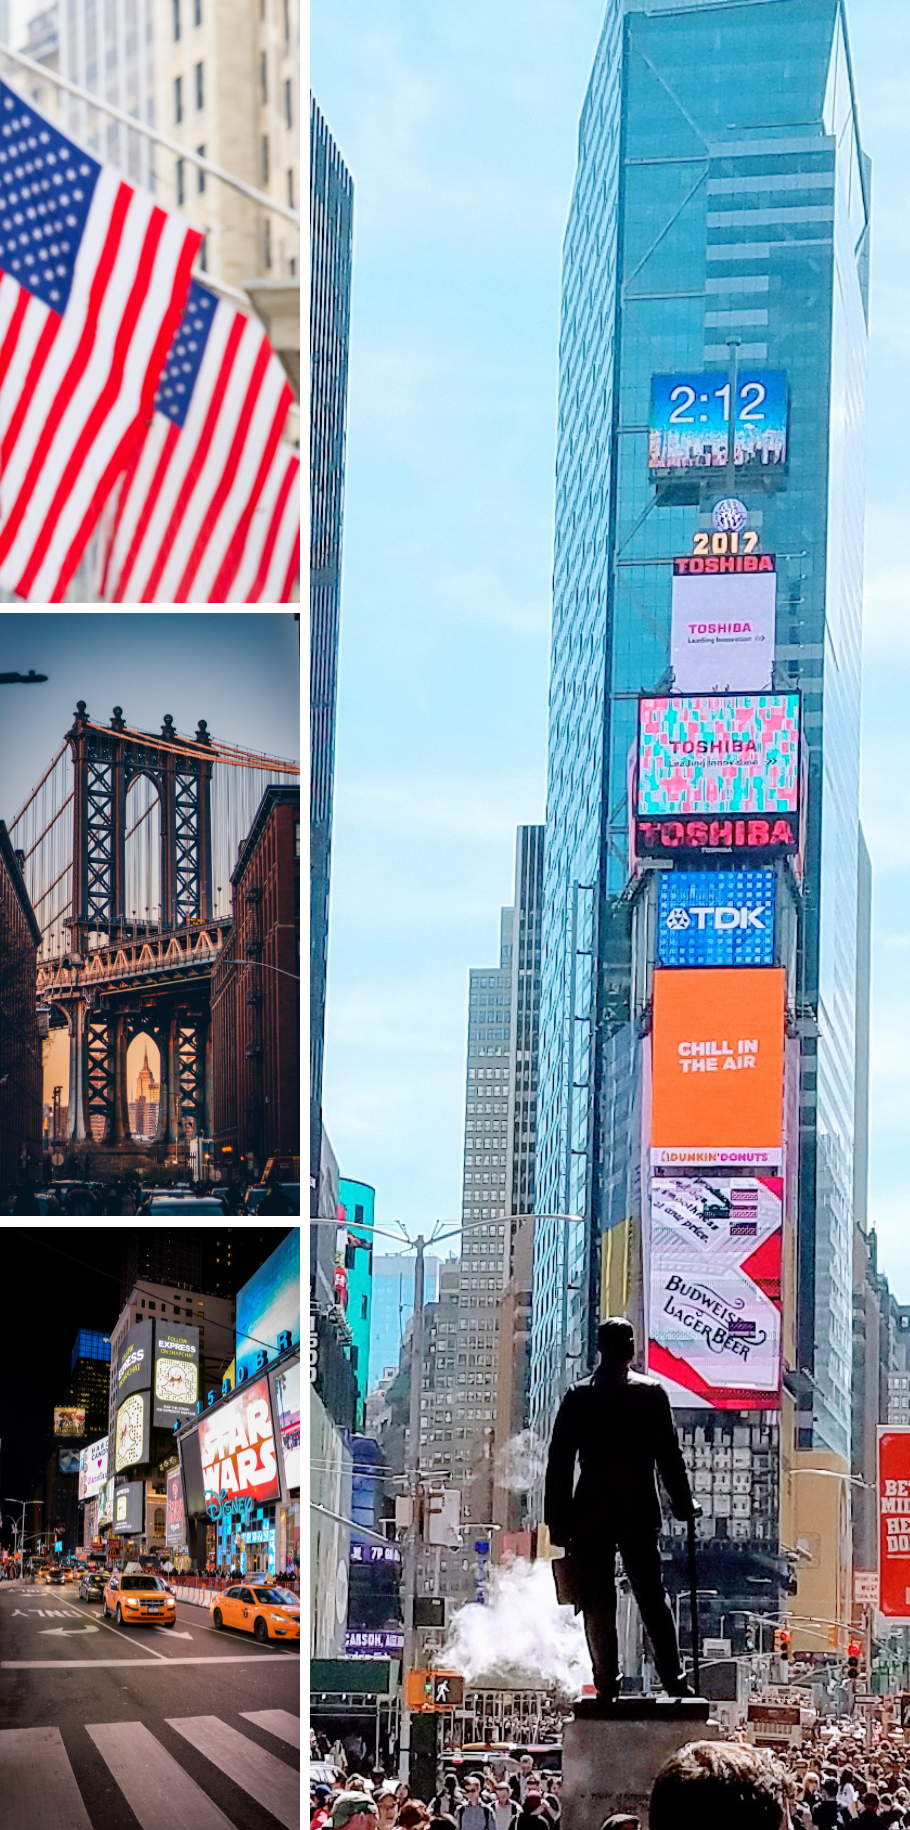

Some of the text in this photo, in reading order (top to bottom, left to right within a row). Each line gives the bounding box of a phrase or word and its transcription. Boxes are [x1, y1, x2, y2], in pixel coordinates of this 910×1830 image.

[669, 382, 766, 423] 2:12
[693, 531, 758, 555] 2017
[674, 555, 774, 575] TOSHIBA
[688, 622, 752, 634] TOSHIBA
[669, 740, 757, 754] TOSHIBA
[638, 820, 795, 848] TOSHIBA
[689, 906, 766, 929] TDK
[677, 1038, 759, 1057] CHILL IN
[679, 1056, 756, 1074] THE AIR
[670, 1152, 768, 1162] DUNKIN' DONUTS
[663, 1295, 751, 1362] LAGER BEER
[158, 1339, 197, 1353] EXPRESS
[167, 1335, 188, 1345] FOLLOW
[202, 1399, 274, 1468] STAR
[203, 1438, 278, 1501] WARS
[10, 1608, 83, 1618] ONLY
